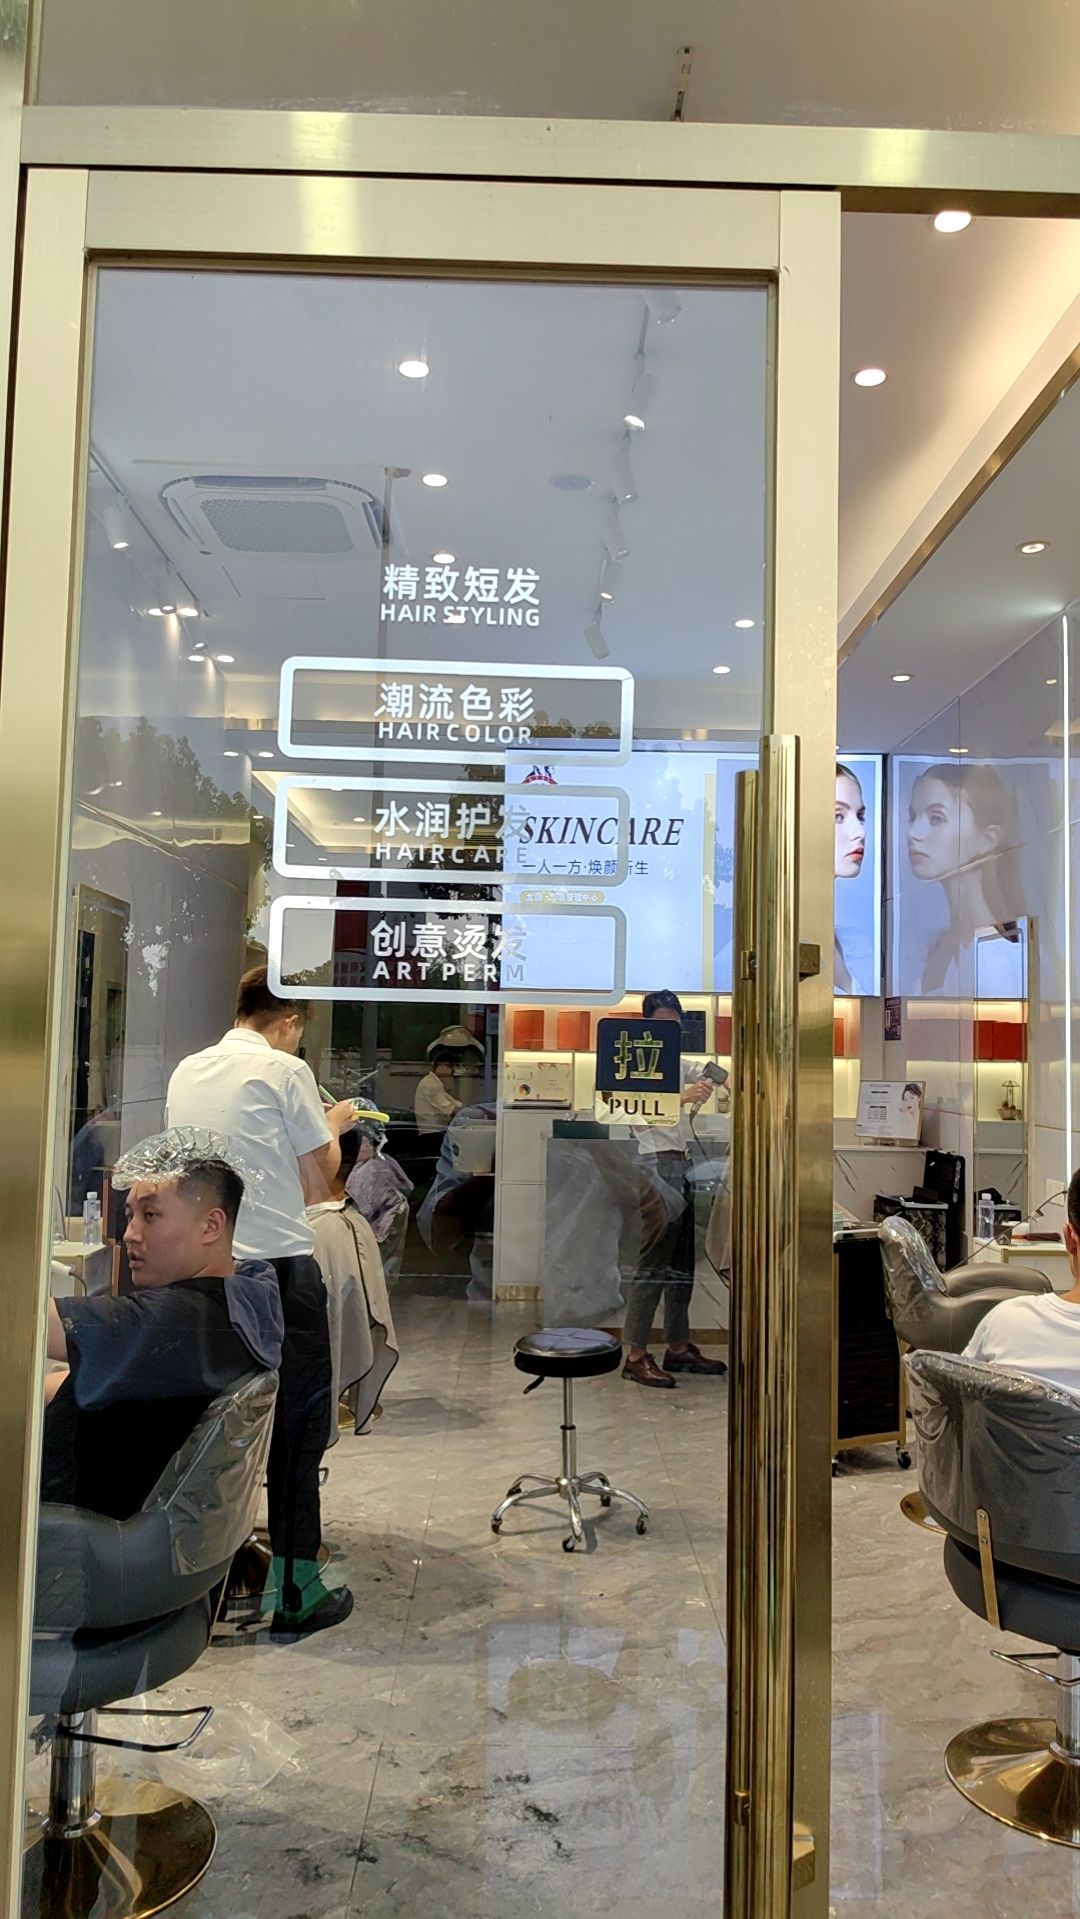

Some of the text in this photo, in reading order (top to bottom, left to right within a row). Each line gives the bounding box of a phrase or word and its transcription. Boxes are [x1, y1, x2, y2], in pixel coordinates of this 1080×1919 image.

[383, 564, 540, 605] 精致短发
[381, 603, 540, 627] HAIR STYLING
[374, 682, 535, 723] 潮流色彩
[375, 800, 531, 840] 水润护发
[370, 920, 527, 962] 创意烫发
[372, 960, 431, 981] ART
[442, 963, 525, 983] PERM
[613, 1030, 664, 1080] 拉
[609, 1098, 665, 1117] PULL
